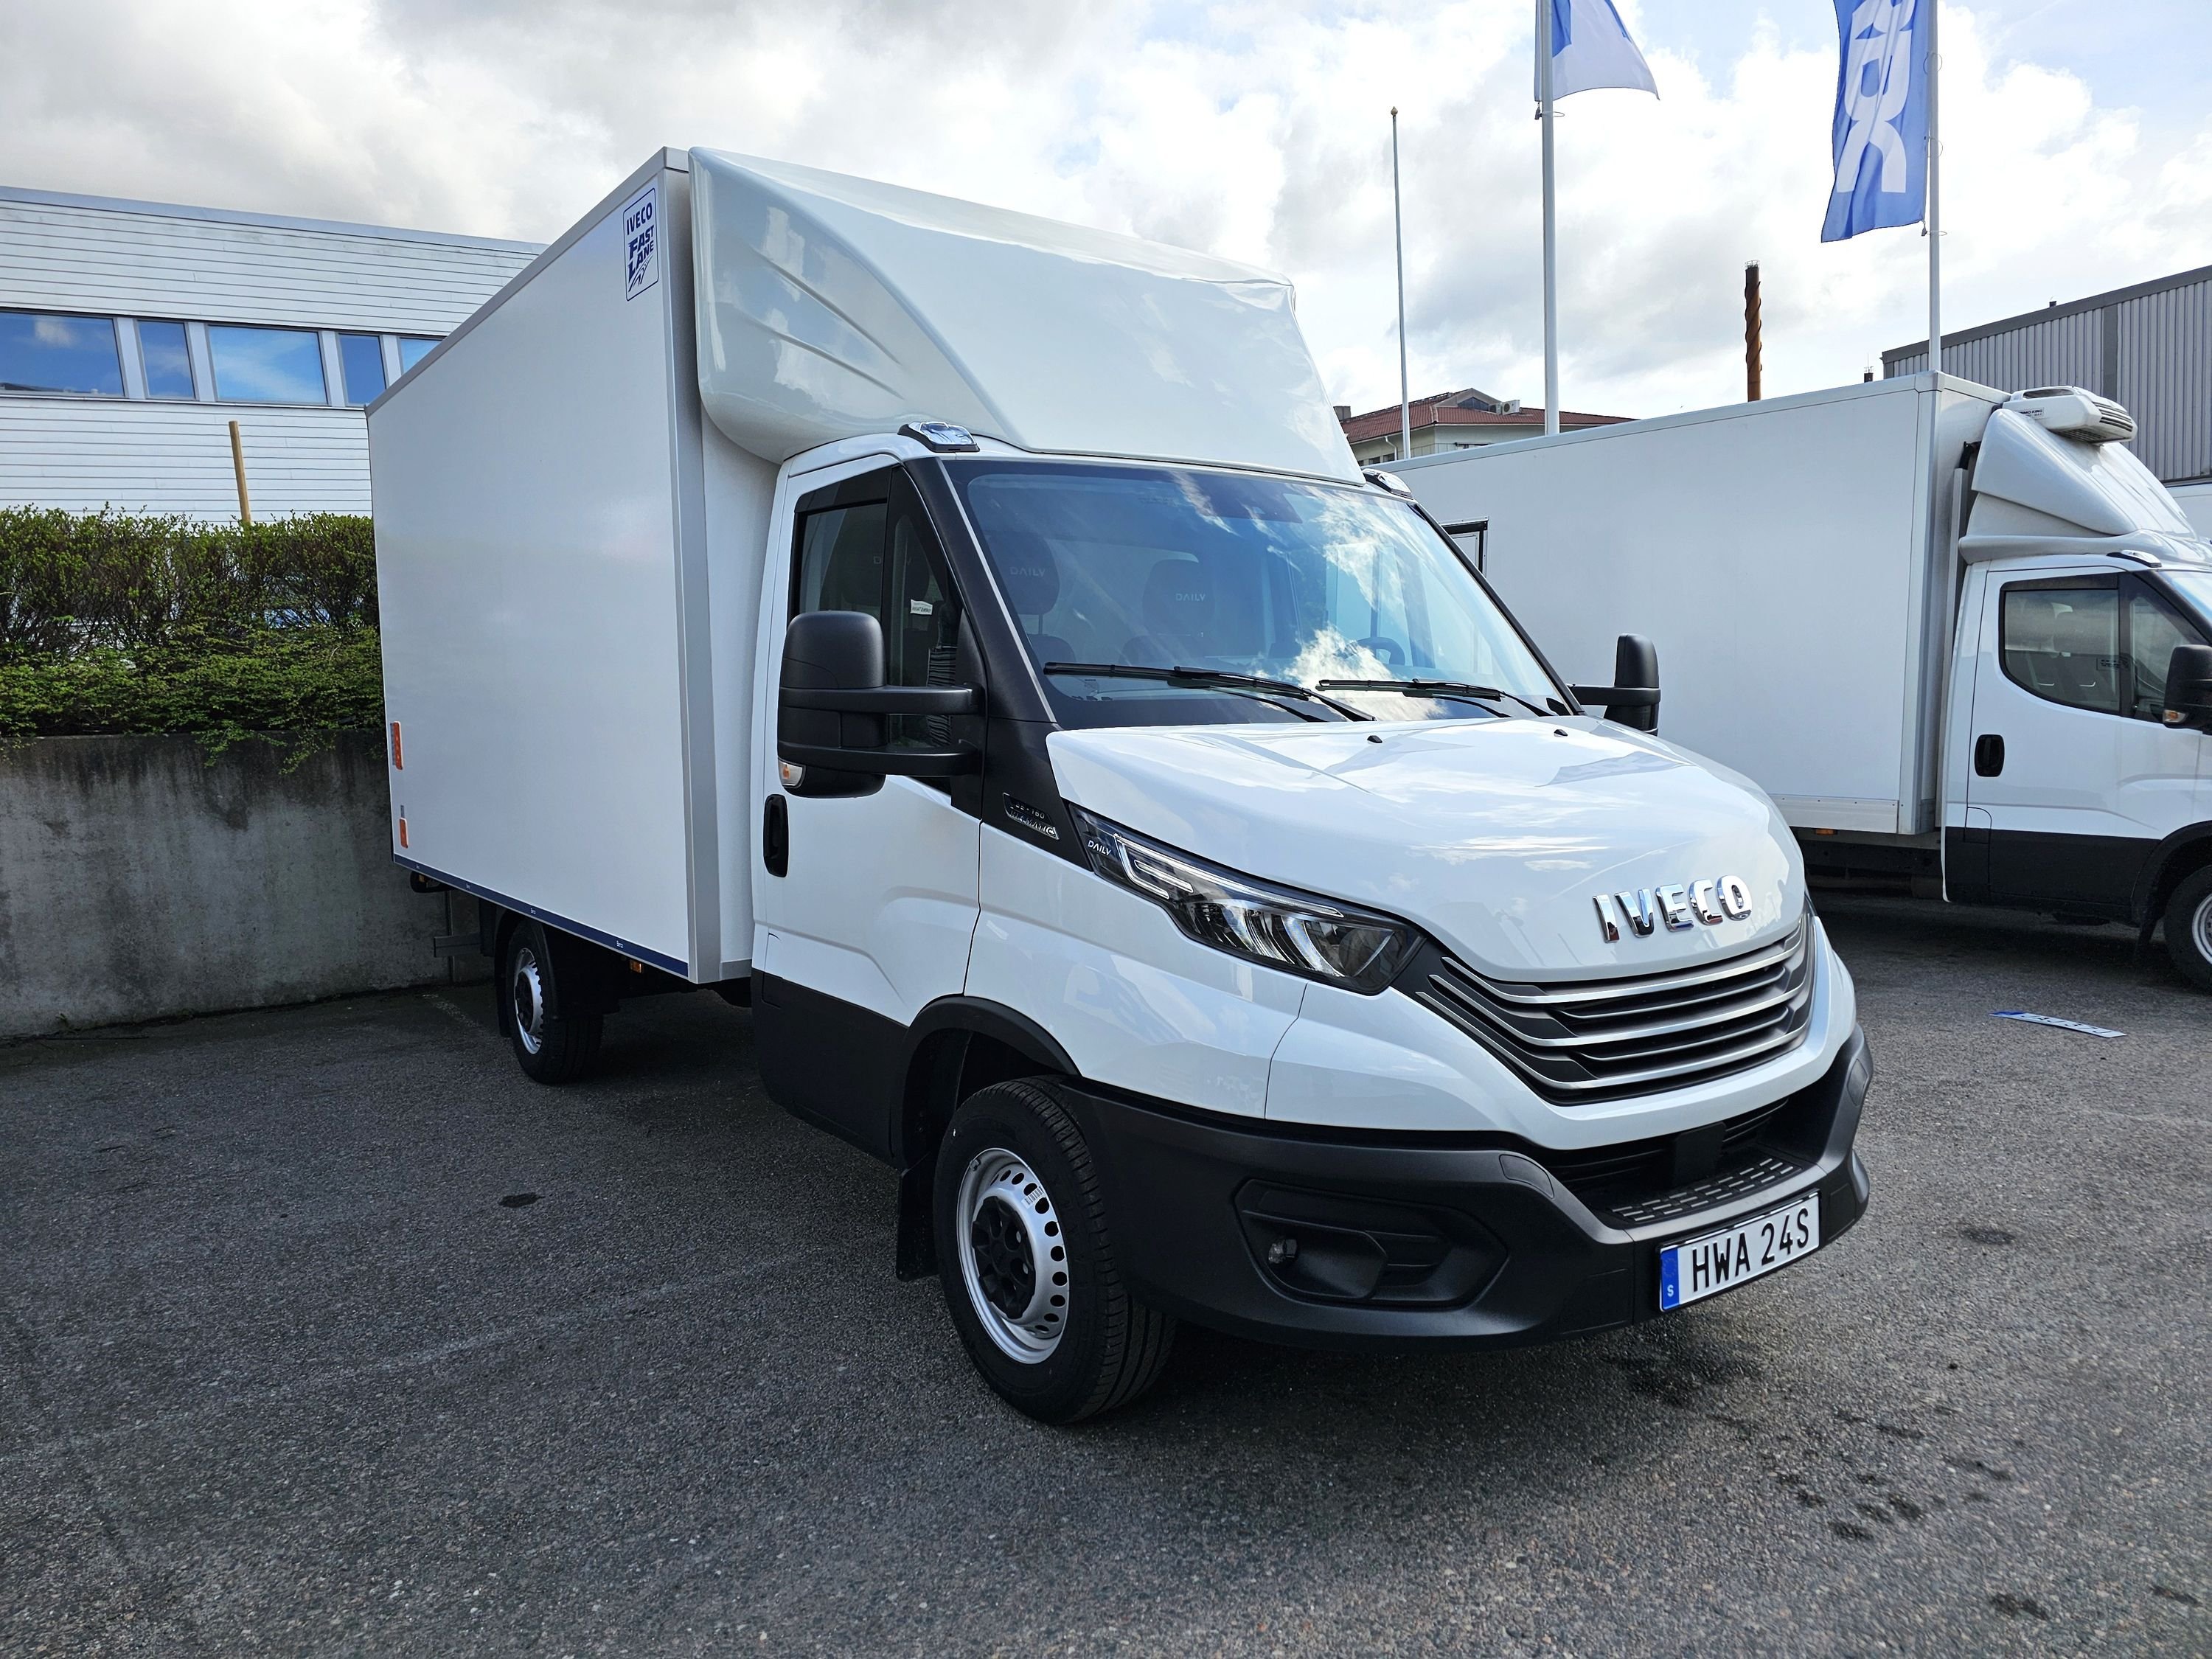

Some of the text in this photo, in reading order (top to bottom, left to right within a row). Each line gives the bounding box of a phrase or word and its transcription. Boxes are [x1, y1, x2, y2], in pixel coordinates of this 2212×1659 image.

[627, 202, 653, 235] IVECO
[628, 224, 655, 260] FAST
[627, 240, 654, 283] LANE
[1009, 566, 1046, 577] DAILY
[1175, 593, 1206, 602] DAILY
[1088, 840, 1112, 856] DAILY
[1593, 875, 1753, 943] IVECO
[1692, 1207, 1809, 1292] HWA 24S
[1667, 1284, 1674, 1297] S
